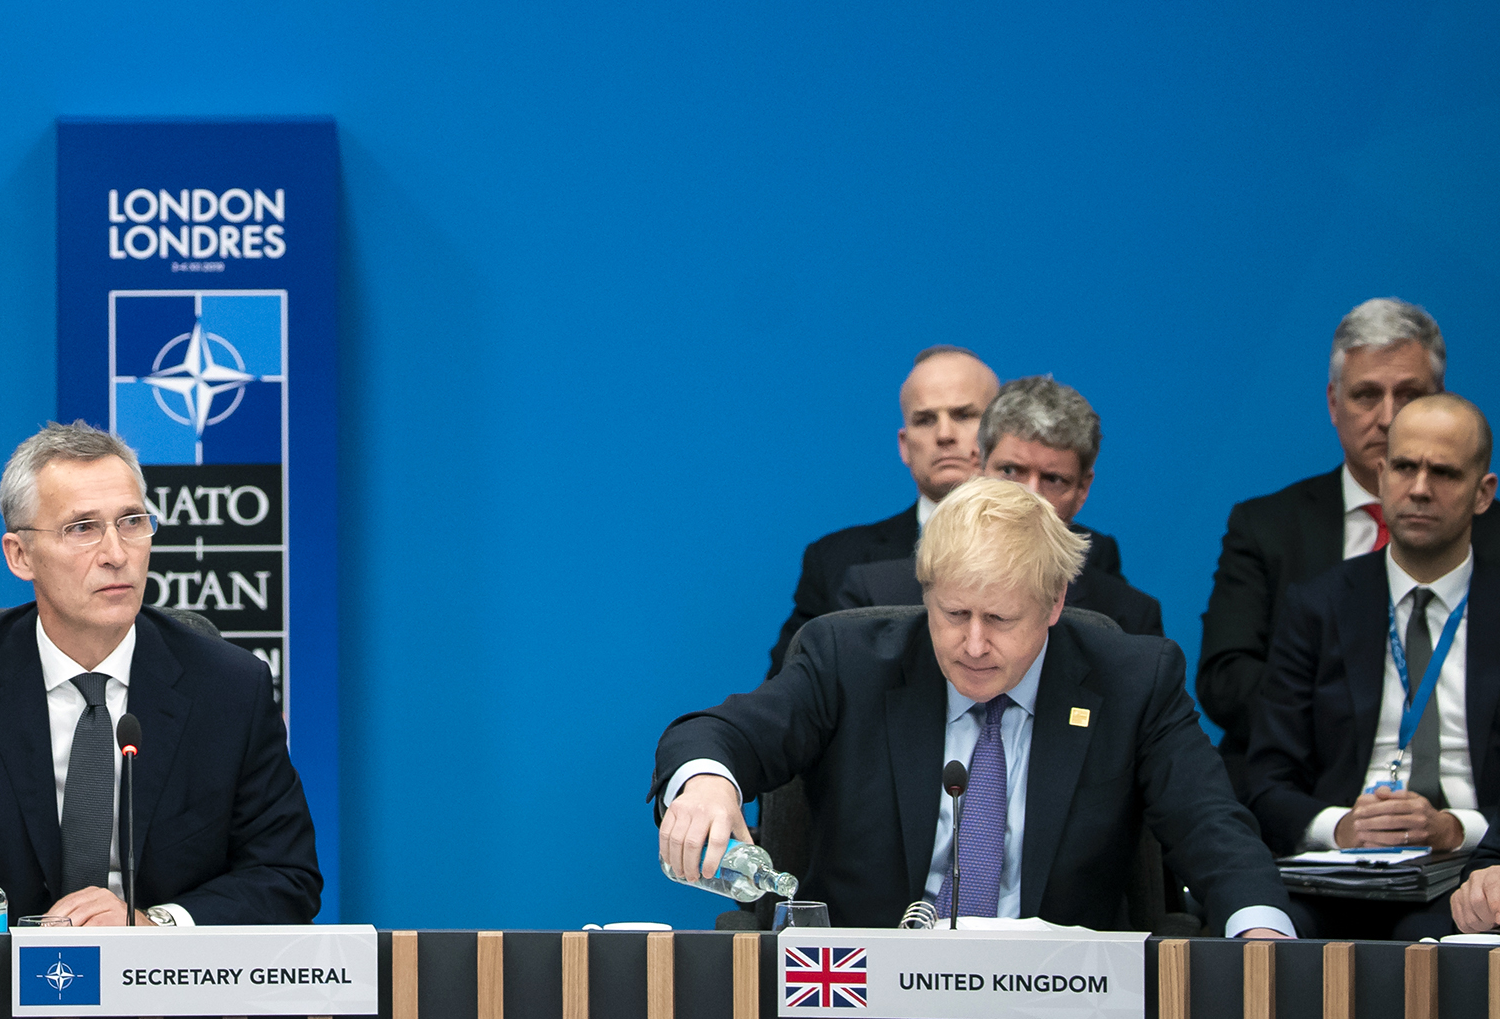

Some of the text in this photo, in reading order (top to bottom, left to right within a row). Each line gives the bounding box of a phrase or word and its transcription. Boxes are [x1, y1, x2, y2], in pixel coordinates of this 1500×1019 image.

[109, 188, 285, 223] LONDON
[109, 224, 286, 259] LONDRES
[122, 967, 352, 986] SECRETARY GENERAL
[899, 973, 1109, 993] UNITED KINGDOM
